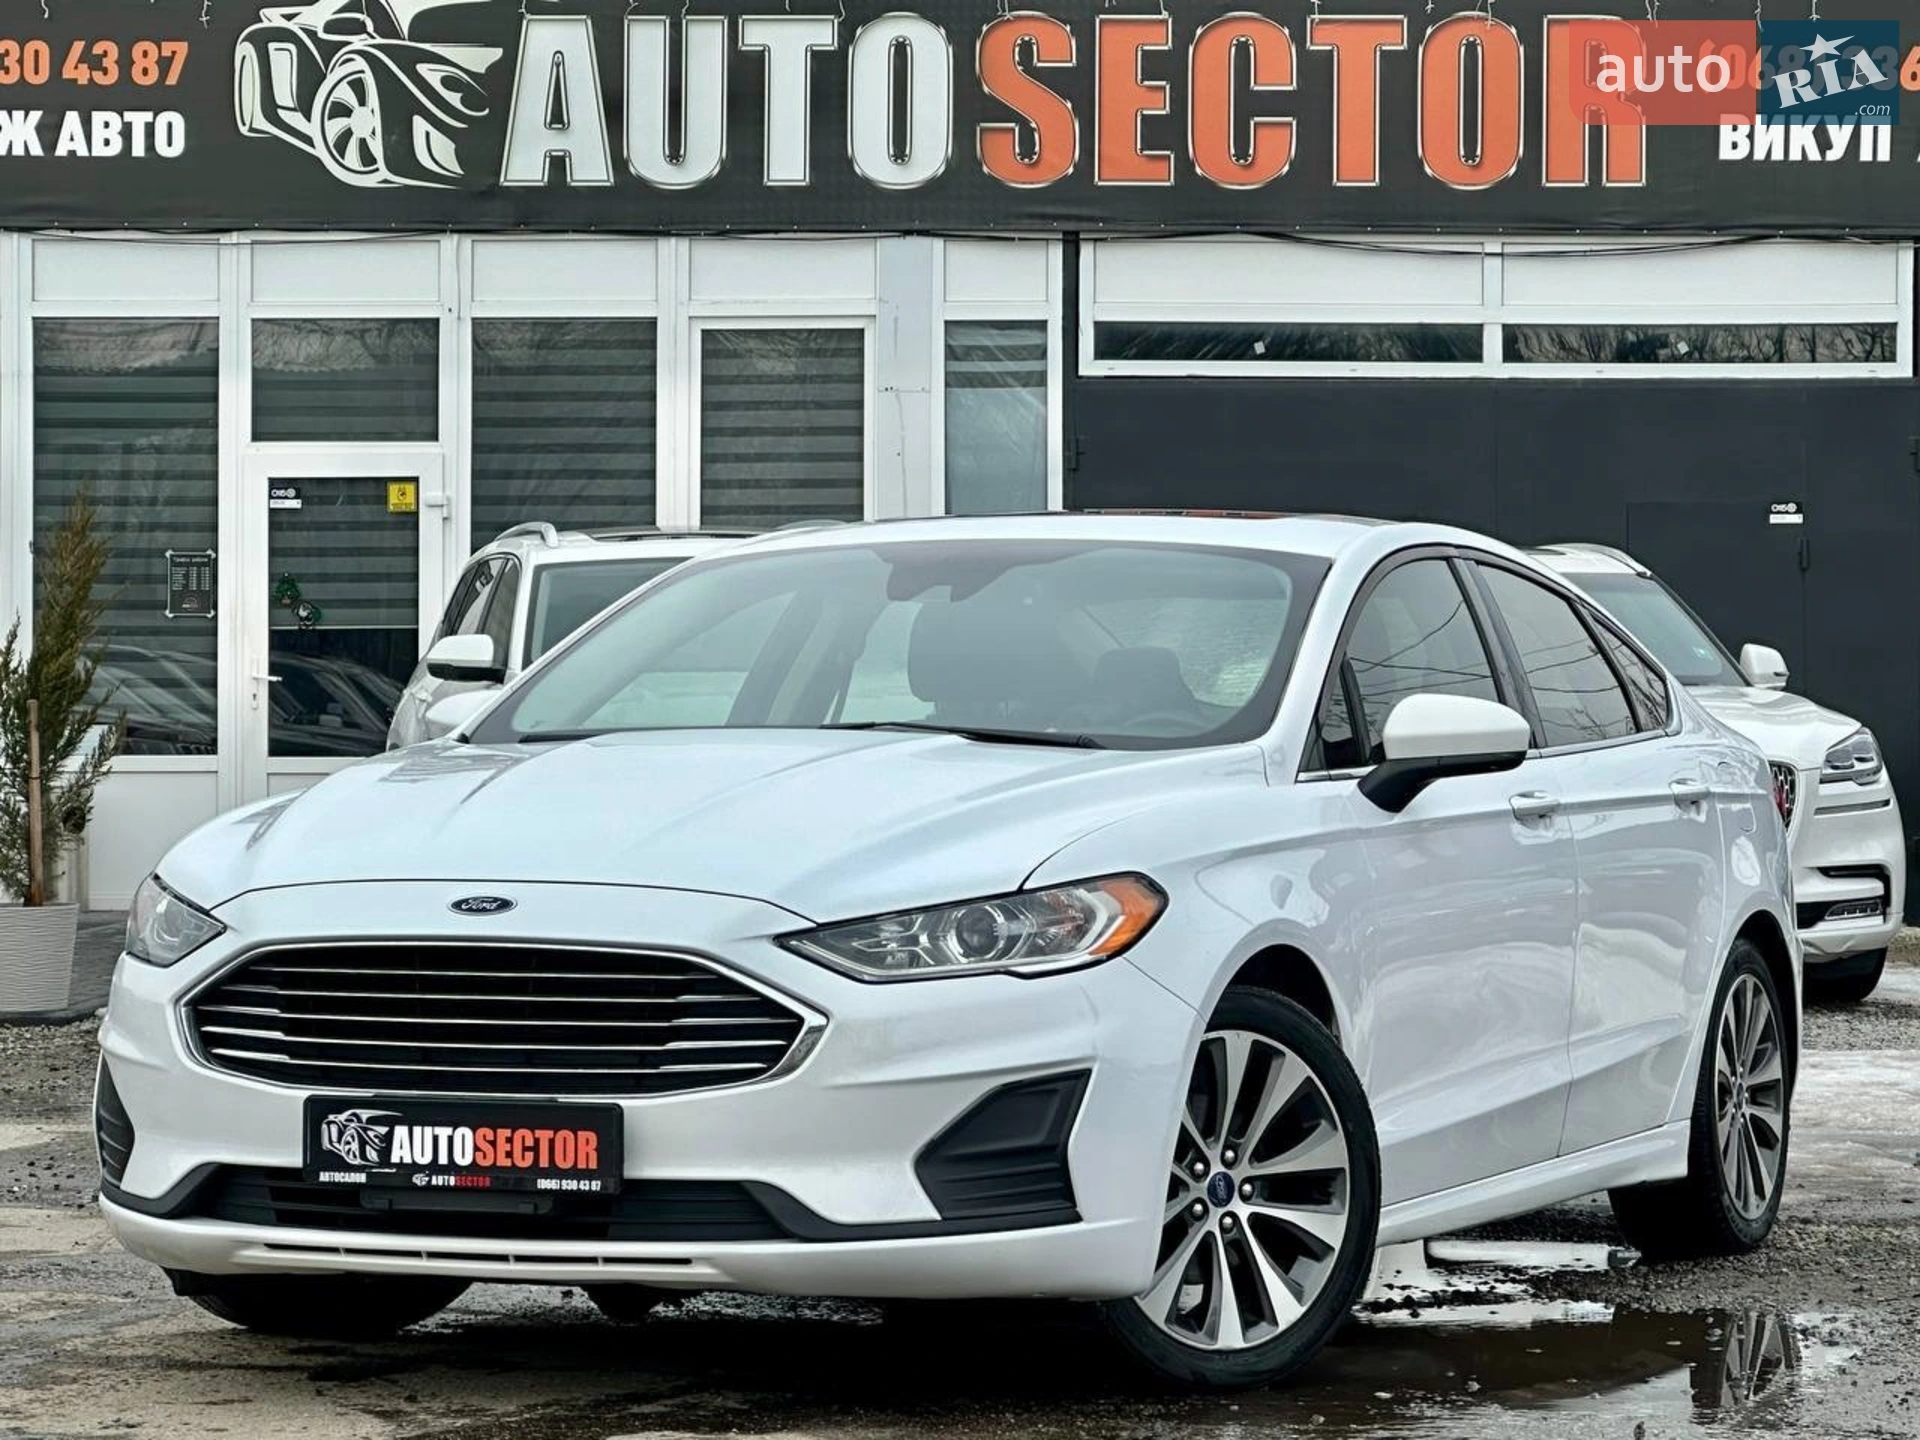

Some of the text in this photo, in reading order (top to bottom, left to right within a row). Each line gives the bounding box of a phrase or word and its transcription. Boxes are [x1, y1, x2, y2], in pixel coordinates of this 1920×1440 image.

[61, 40, 119, 86] 43
[131, 41, 188, 86] 87
[499, 11, 1647, 189] AUTOSECTOR
[54, 110, 185, 158] АВТО
[1718, 113, 1892, 162] ВИКУП
[460, 897, 502, 910] Ford
[390, 1125, 599, 1170] AUTOSECTOR
